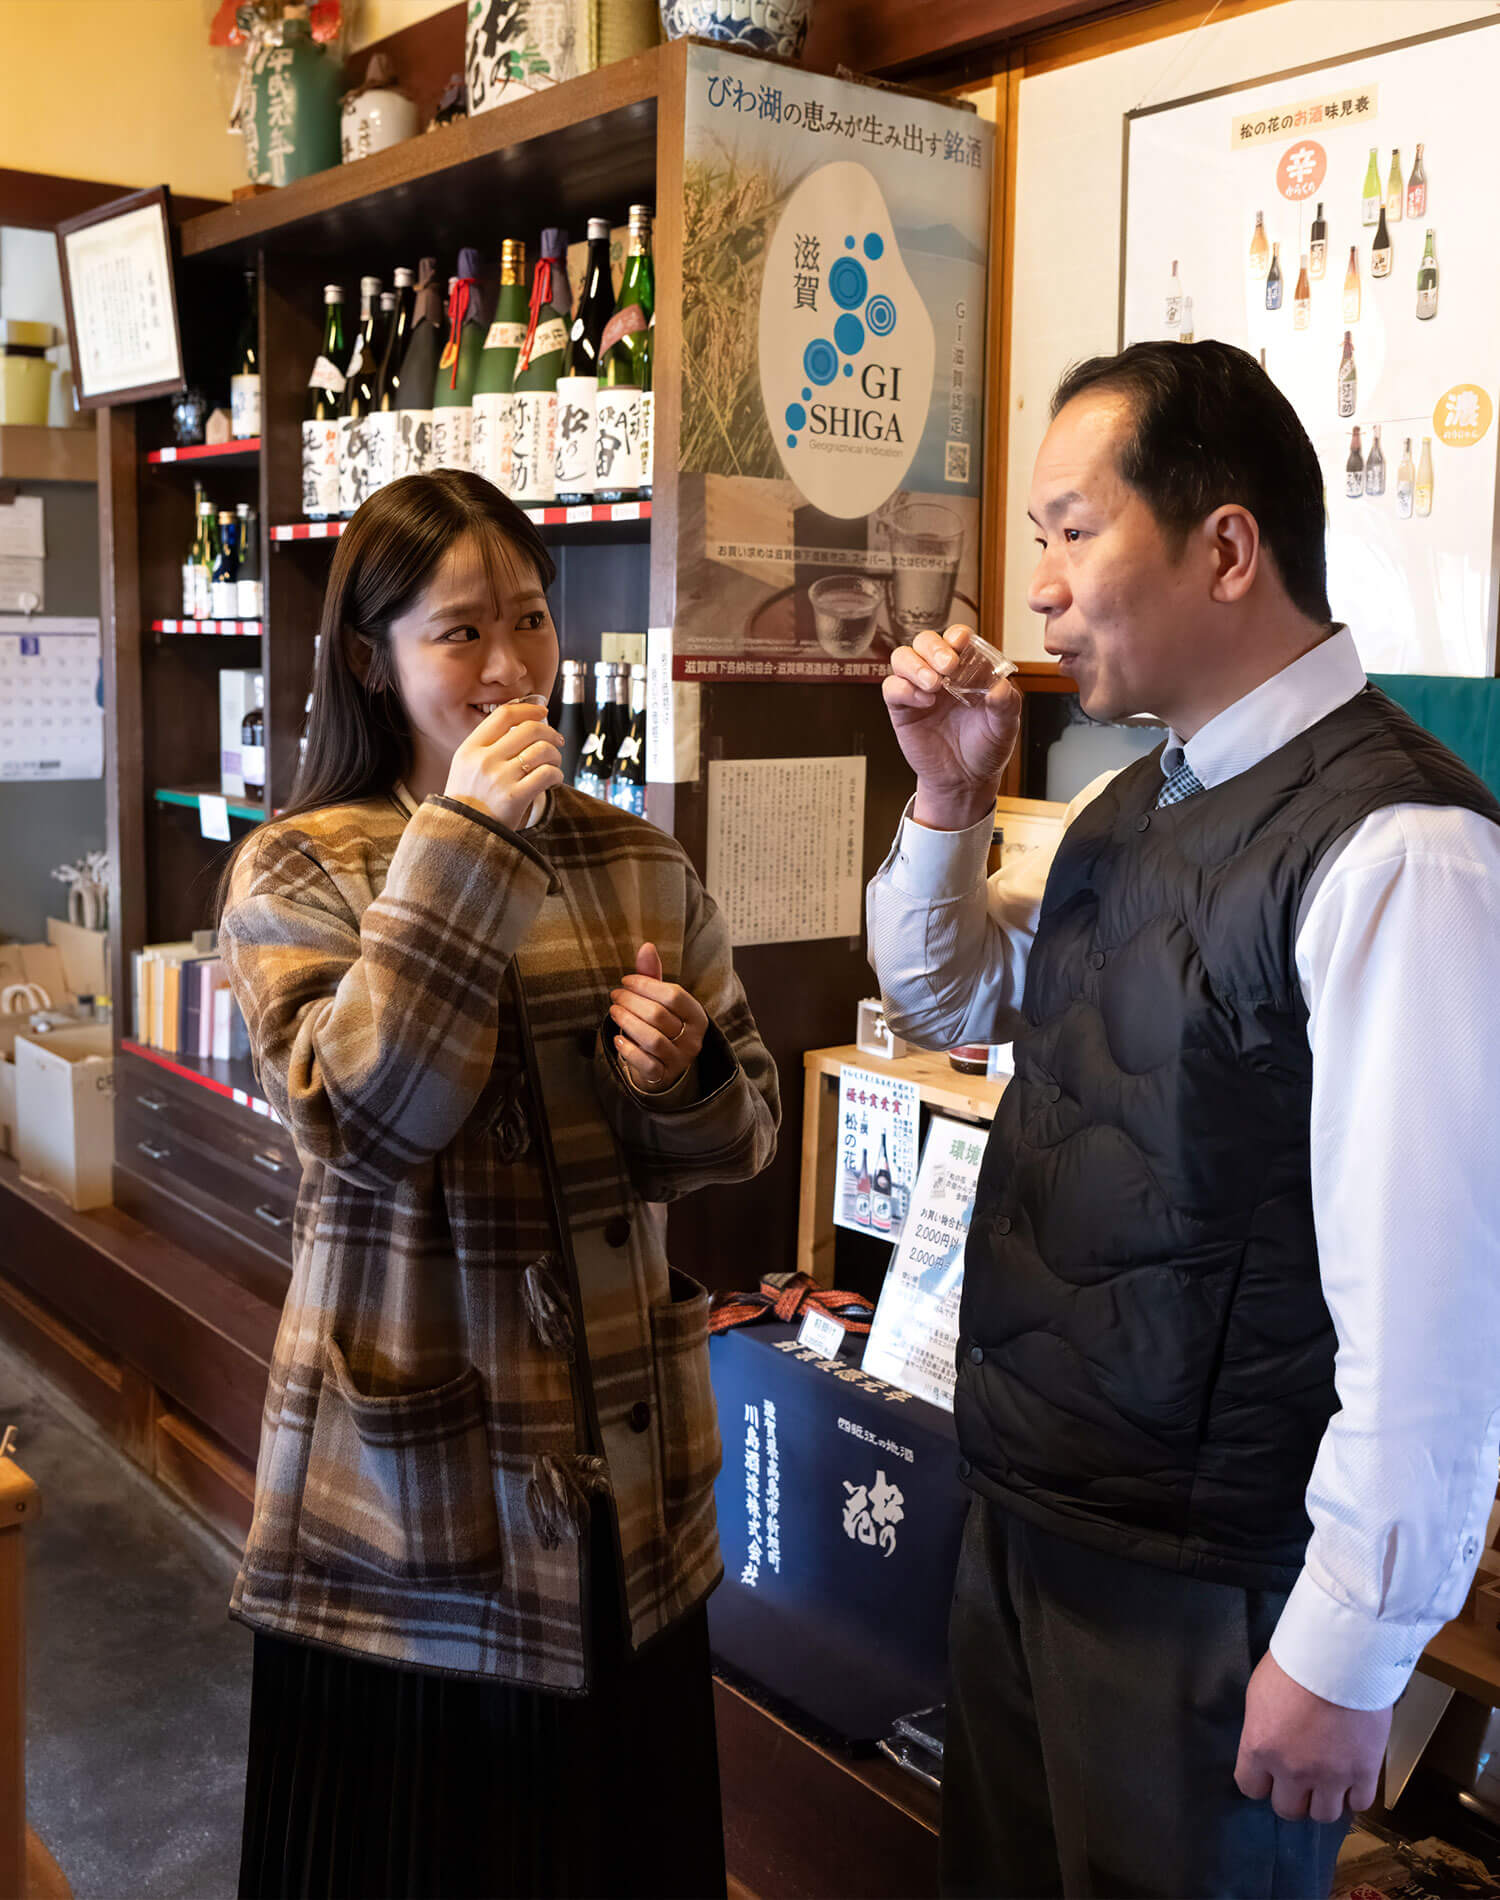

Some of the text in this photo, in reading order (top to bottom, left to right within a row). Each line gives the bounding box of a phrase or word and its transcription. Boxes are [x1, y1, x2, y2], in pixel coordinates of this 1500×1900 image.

[707, 74, 983, 170] びわ湖の恵みが生み出す銘酒
[1285, 146, 1318, 183] 辛
[794, 233, 821, 313] 滋賀
[861, 363, 902, 402] GI
[808, 403, 905, 444] SHIGA
[1444, 390, 1481, 428] 濃
[808, 438, 864, 456] Geographical
[843, 1111, 859, 1171] 松の花
[740, 1402, 763, 1588] 川島酒造株式会社
[842, 1469, 906, 1559] 松の花
